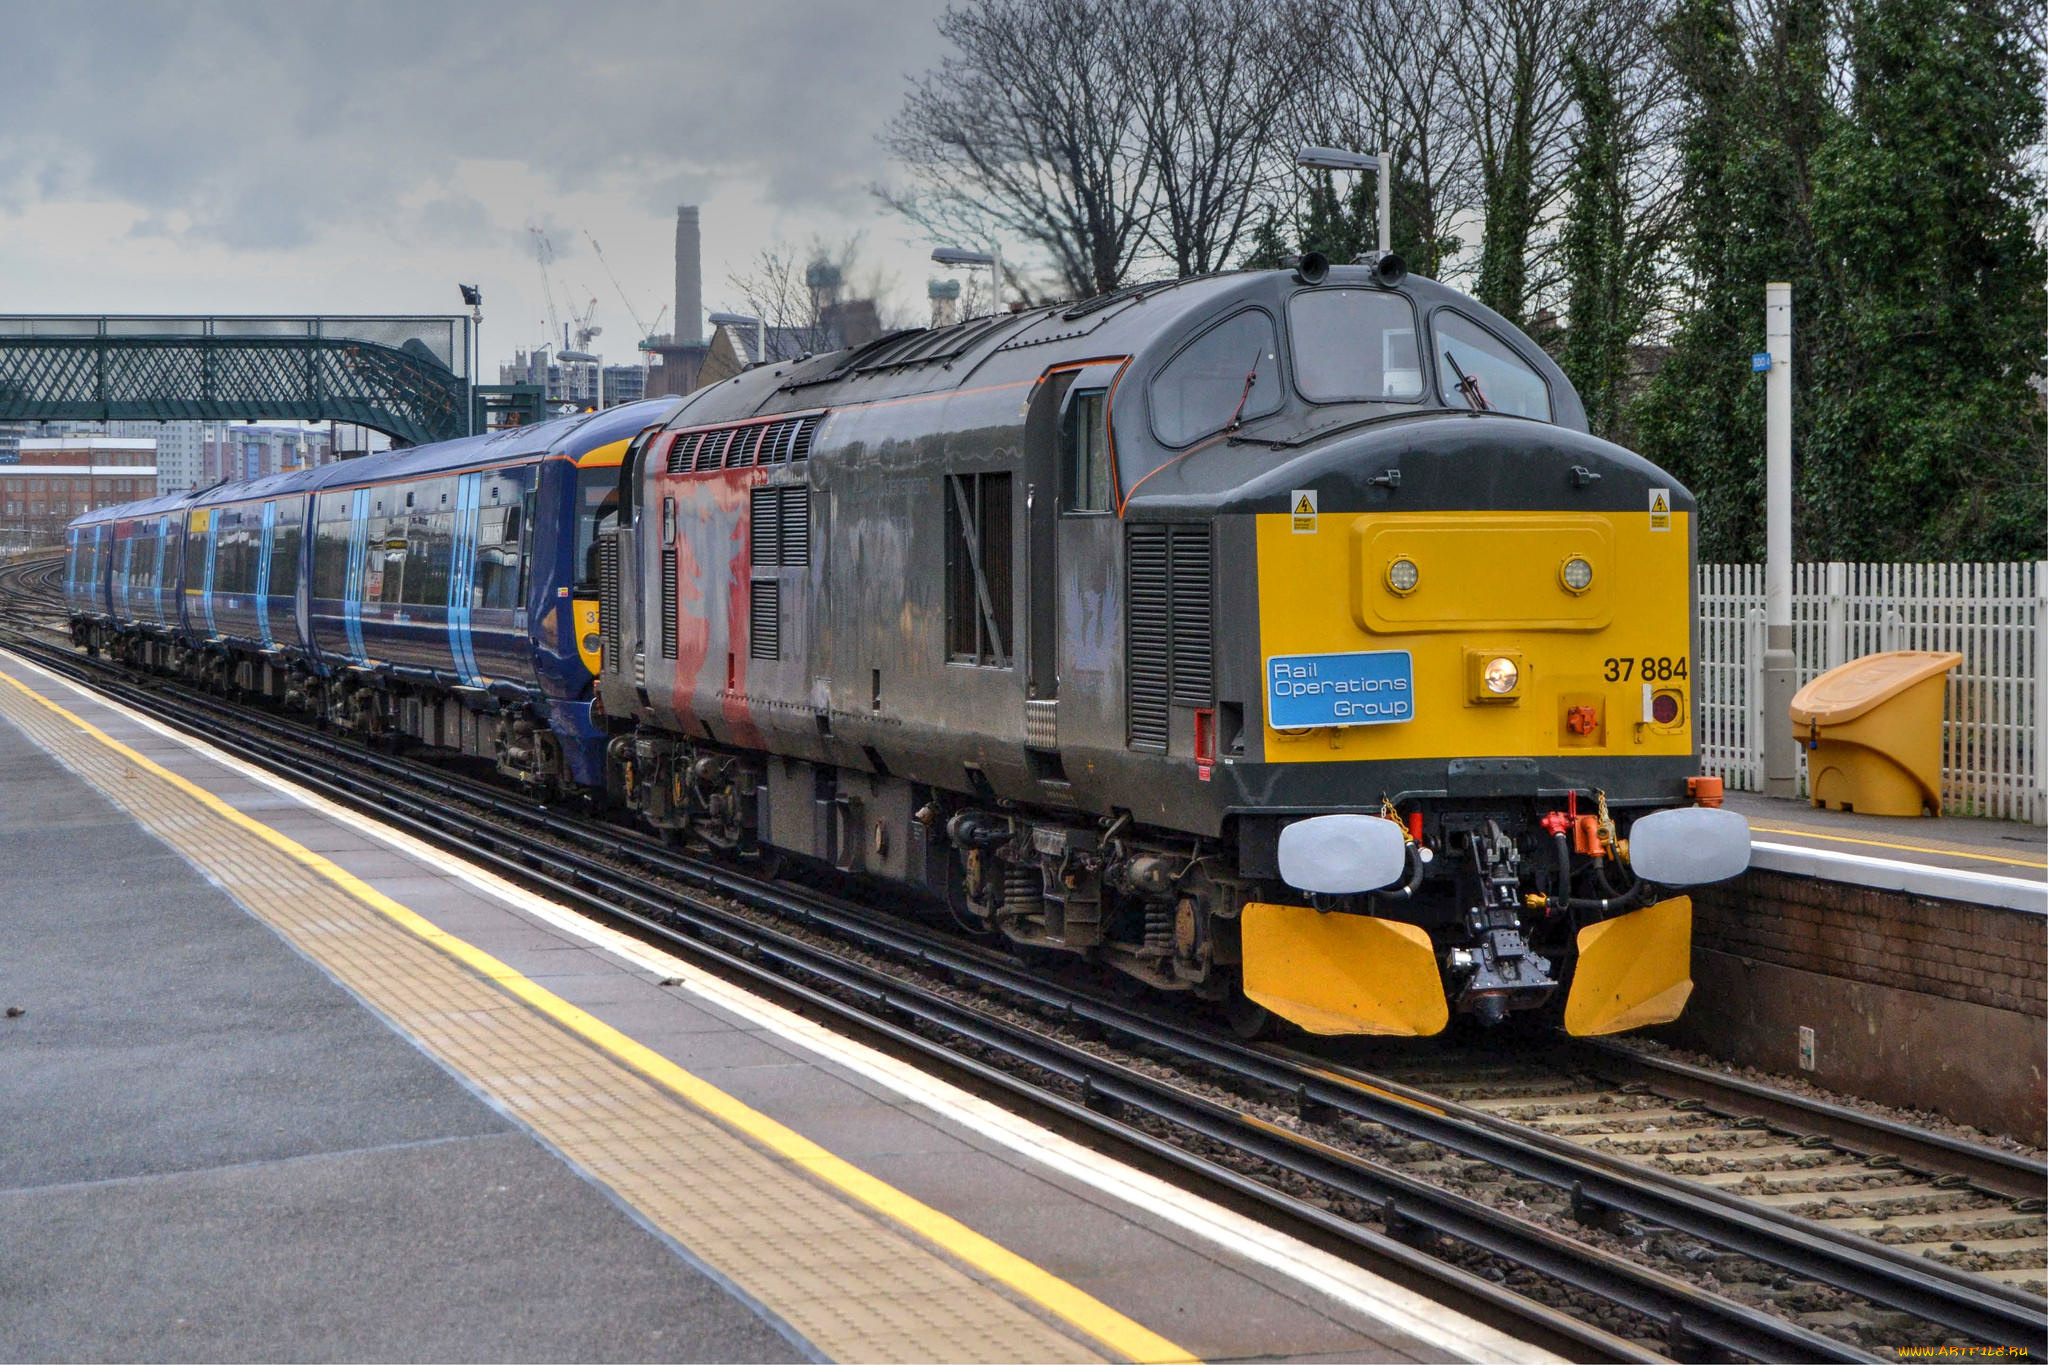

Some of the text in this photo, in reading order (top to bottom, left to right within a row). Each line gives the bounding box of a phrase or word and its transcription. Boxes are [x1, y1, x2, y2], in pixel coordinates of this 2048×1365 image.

[1274, 663, 1318, 679] Rail
[1604, 656, 1687, 682] 37 884
[1274, 677, 1408, 698] Operations
[1333, 700, 1409, 717] Group
